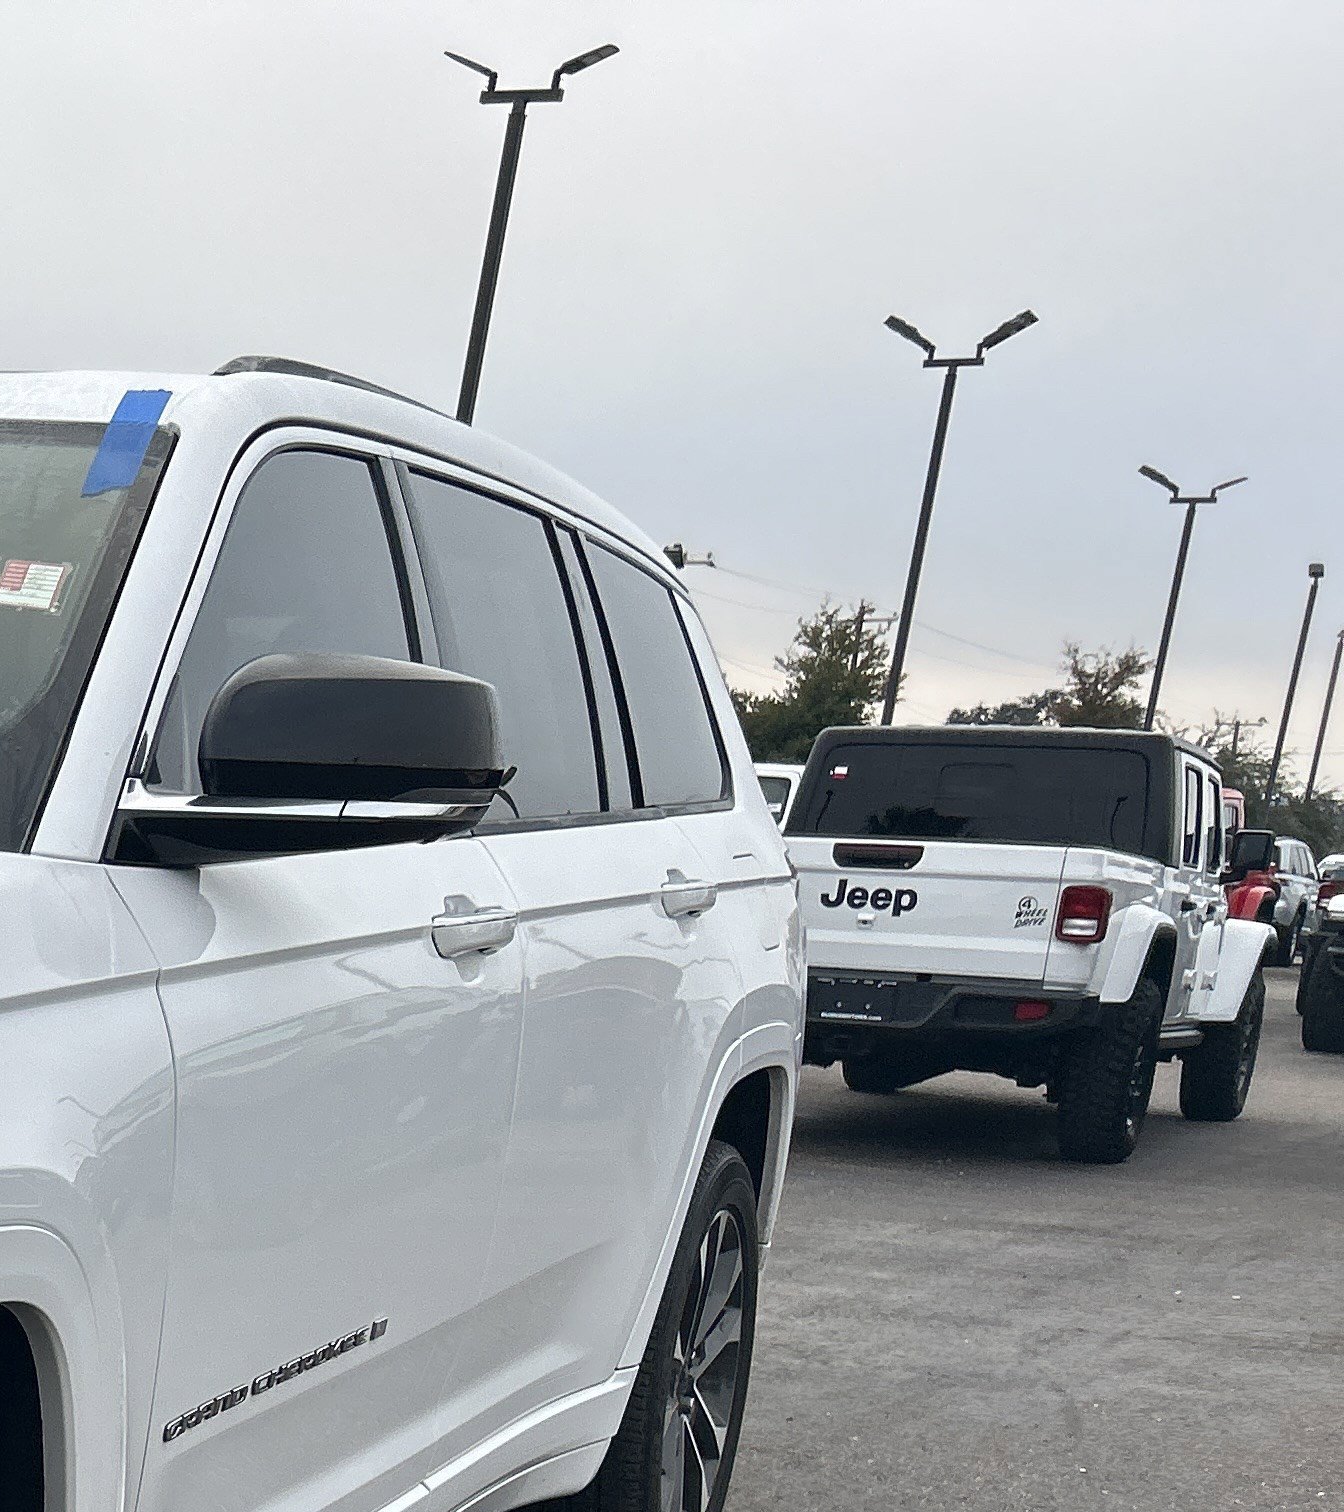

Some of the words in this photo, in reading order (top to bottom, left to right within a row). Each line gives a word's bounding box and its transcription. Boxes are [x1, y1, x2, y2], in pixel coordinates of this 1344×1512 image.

[820, 878, 918, 917] Jeep
[1013, 917, 1047, 929] DRIVE
[1015, 908, 1048, 919] WHEEL
[161, 1384, 250, 1443] GRAND
[250, 1325, 370, 1397] CHEROKEE
